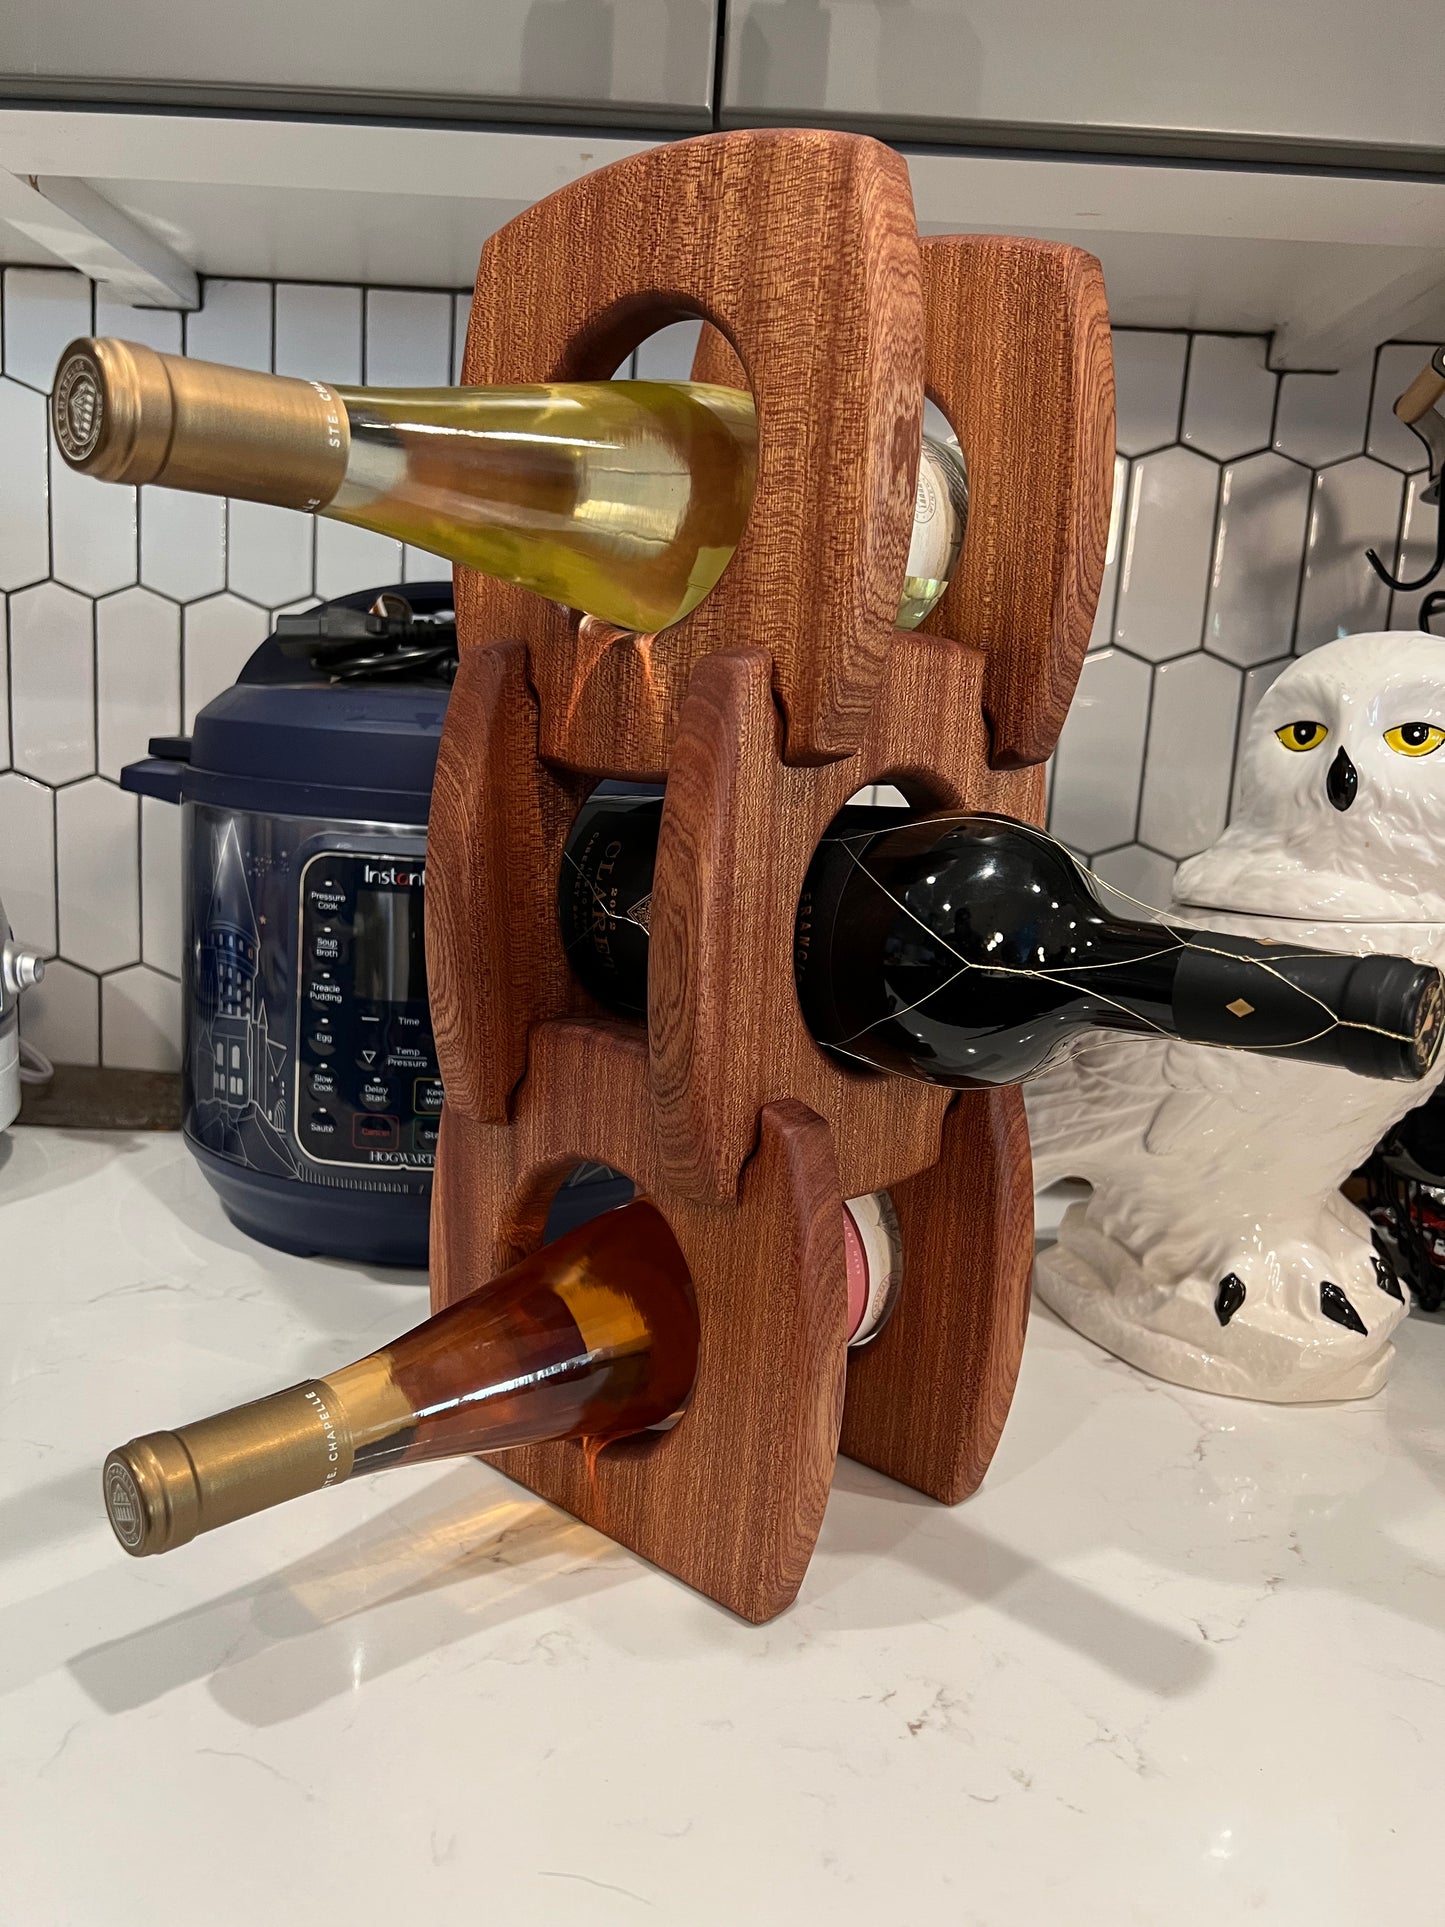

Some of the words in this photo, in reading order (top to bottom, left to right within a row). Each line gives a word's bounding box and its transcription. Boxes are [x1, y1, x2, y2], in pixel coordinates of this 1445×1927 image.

[364, 864, 426, 887] Instant
[311, 890, 346, 902] Pressure
[317, 902, 339, 911] Cook
[317, 937, 338, 948] Soup
[316, 949, 338, 958] Broth
[311, 982, 341, 993] Treacle
[309, 992, 342, 1004] Pudding
[398, 1016, 420, 1026] Time
[316, 1033, 333, 1044] Egg
[396, 1046, 420, 1057] Temp
[387, 1058, 428, 1068] Pressure
[314, 1074, 333, 1083] Slow
[313, 1083, 333, 1092] Cook
[364, 1084, 389, 1096] Delay
[426, 1088, 444, 1096] Kee
[366, 1094, 387, 1103] Start
[305, 1391, 339, 1462] CHAPELLE
